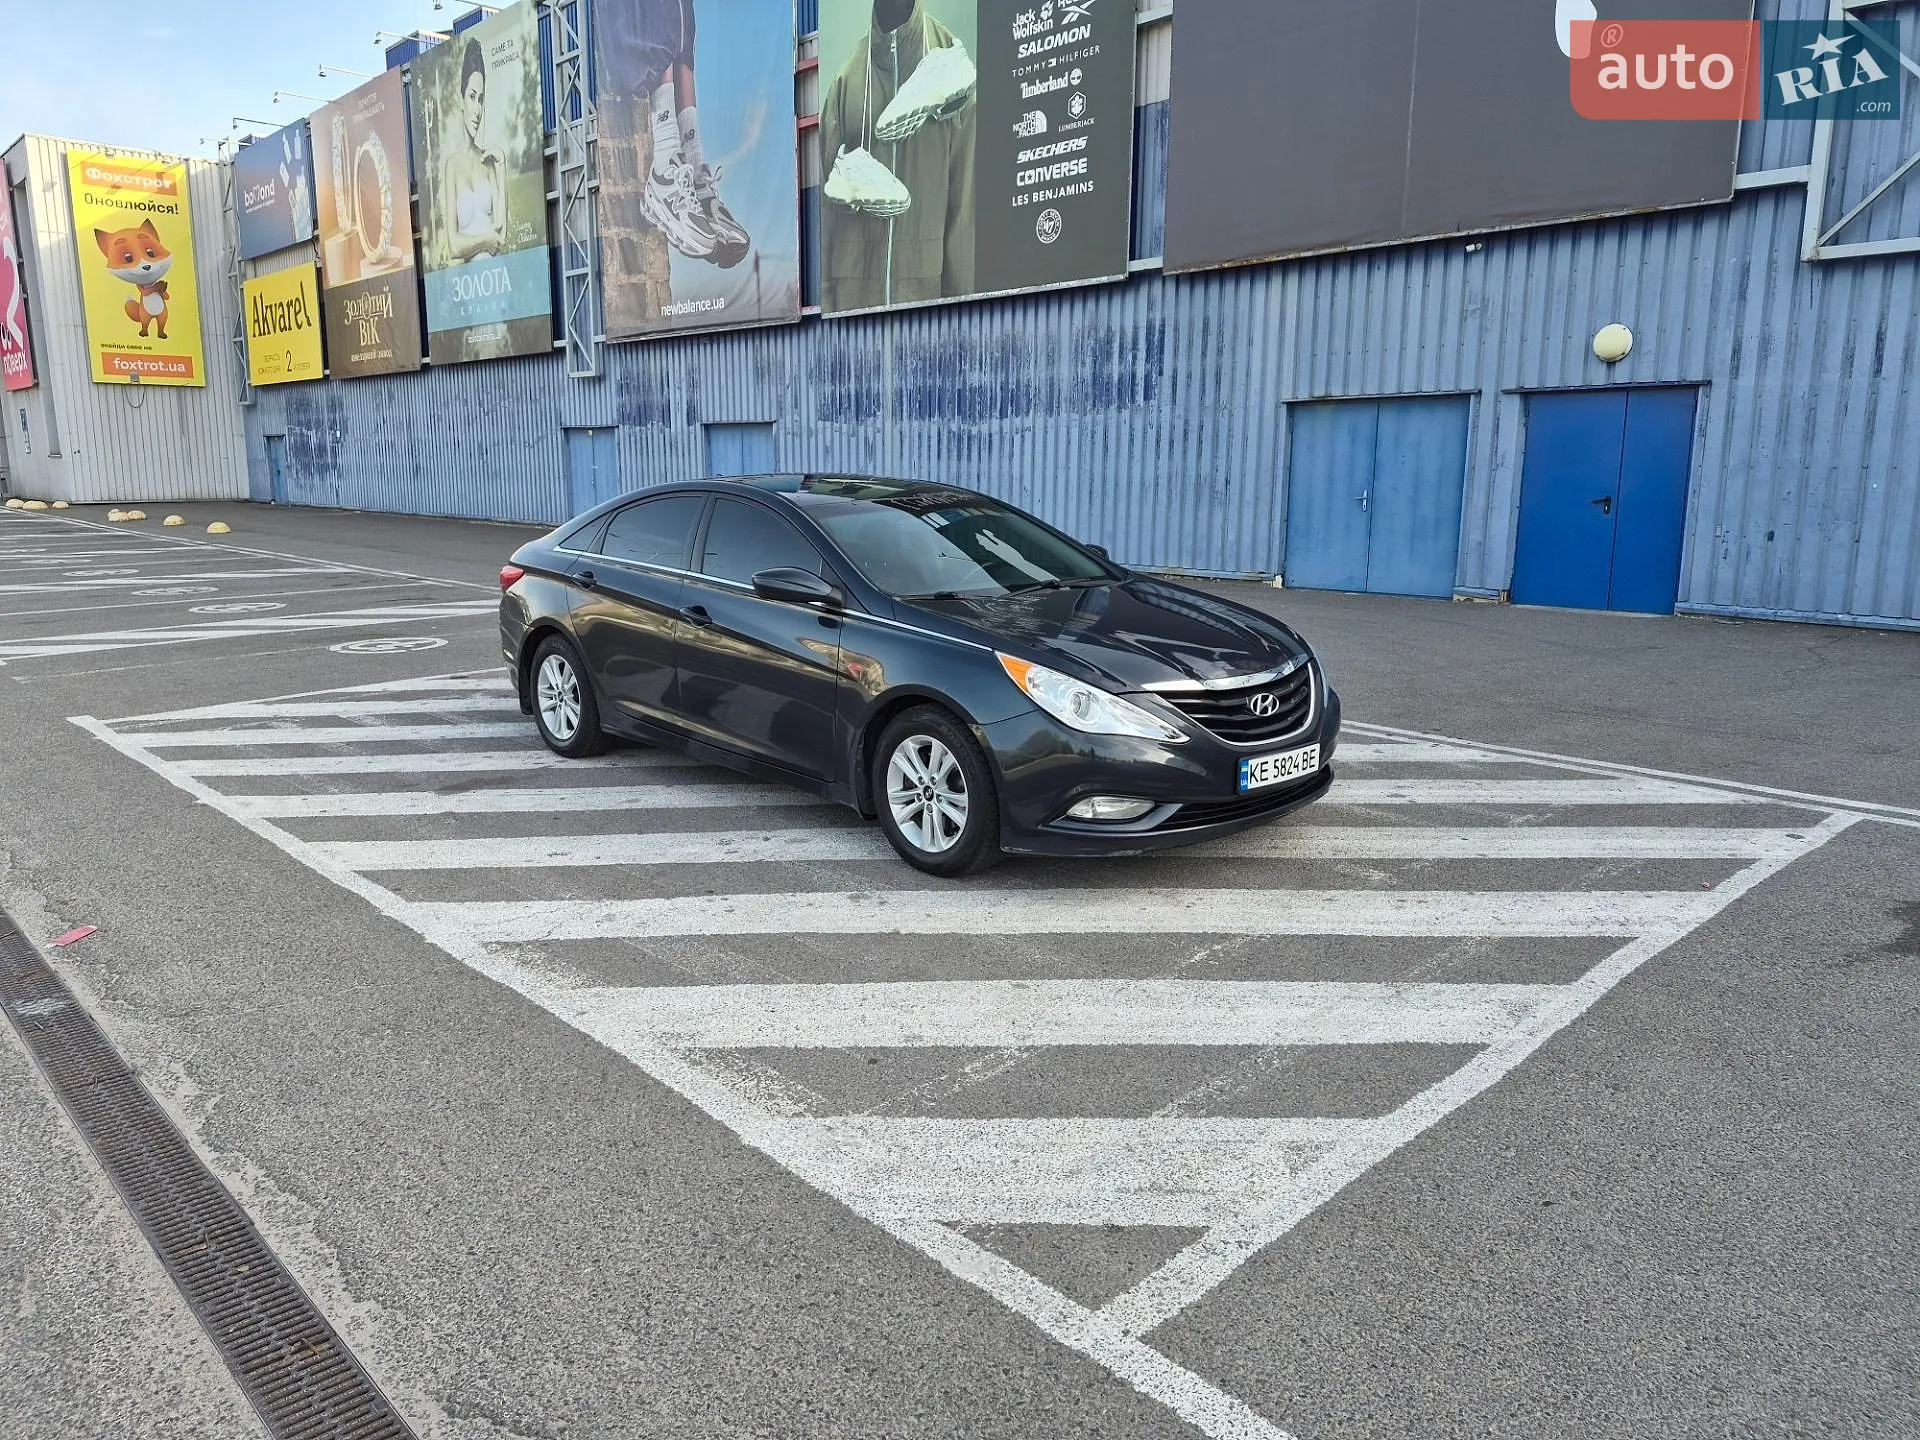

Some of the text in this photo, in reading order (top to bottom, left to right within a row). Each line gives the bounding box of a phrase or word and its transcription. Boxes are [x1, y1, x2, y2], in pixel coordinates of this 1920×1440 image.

[1012, 18, 1054, 40] Wolfskin
[1013, 8, 1036, 27] Jack
[1017, 23, 1092, 59] SALOMON
[1012, 45, 1101, 79] TOMMY HILFIGER
[1020, 71, 1069, 99] Timberland
[1012, 119, 1036, 133] NORTH
[1022, 111, 1037, 122] THE
[1058, 117, 1095, 133] LUMBERJACK
[1017, 128, 1036, 138] FACE
[1016, 136, 1089, 164] SKECHERS
[1016, 157, 1088, 187] CONVERSE
[84, 192, 179, 215] Оновлюйся!
[1012, 180, 1094, 207] LES BENJAMINS
[452, 265, 512, 302] ЗОЛОТА
[252, 280, 312, 338] Akvarel
[661, 297, 725, 317] newbalance.ua
[113, 358, 186, 373] foxtrot.ua
[286, 350, 292, 372] 2
[1249, 748, 1316, 785] KE 5824 BE
